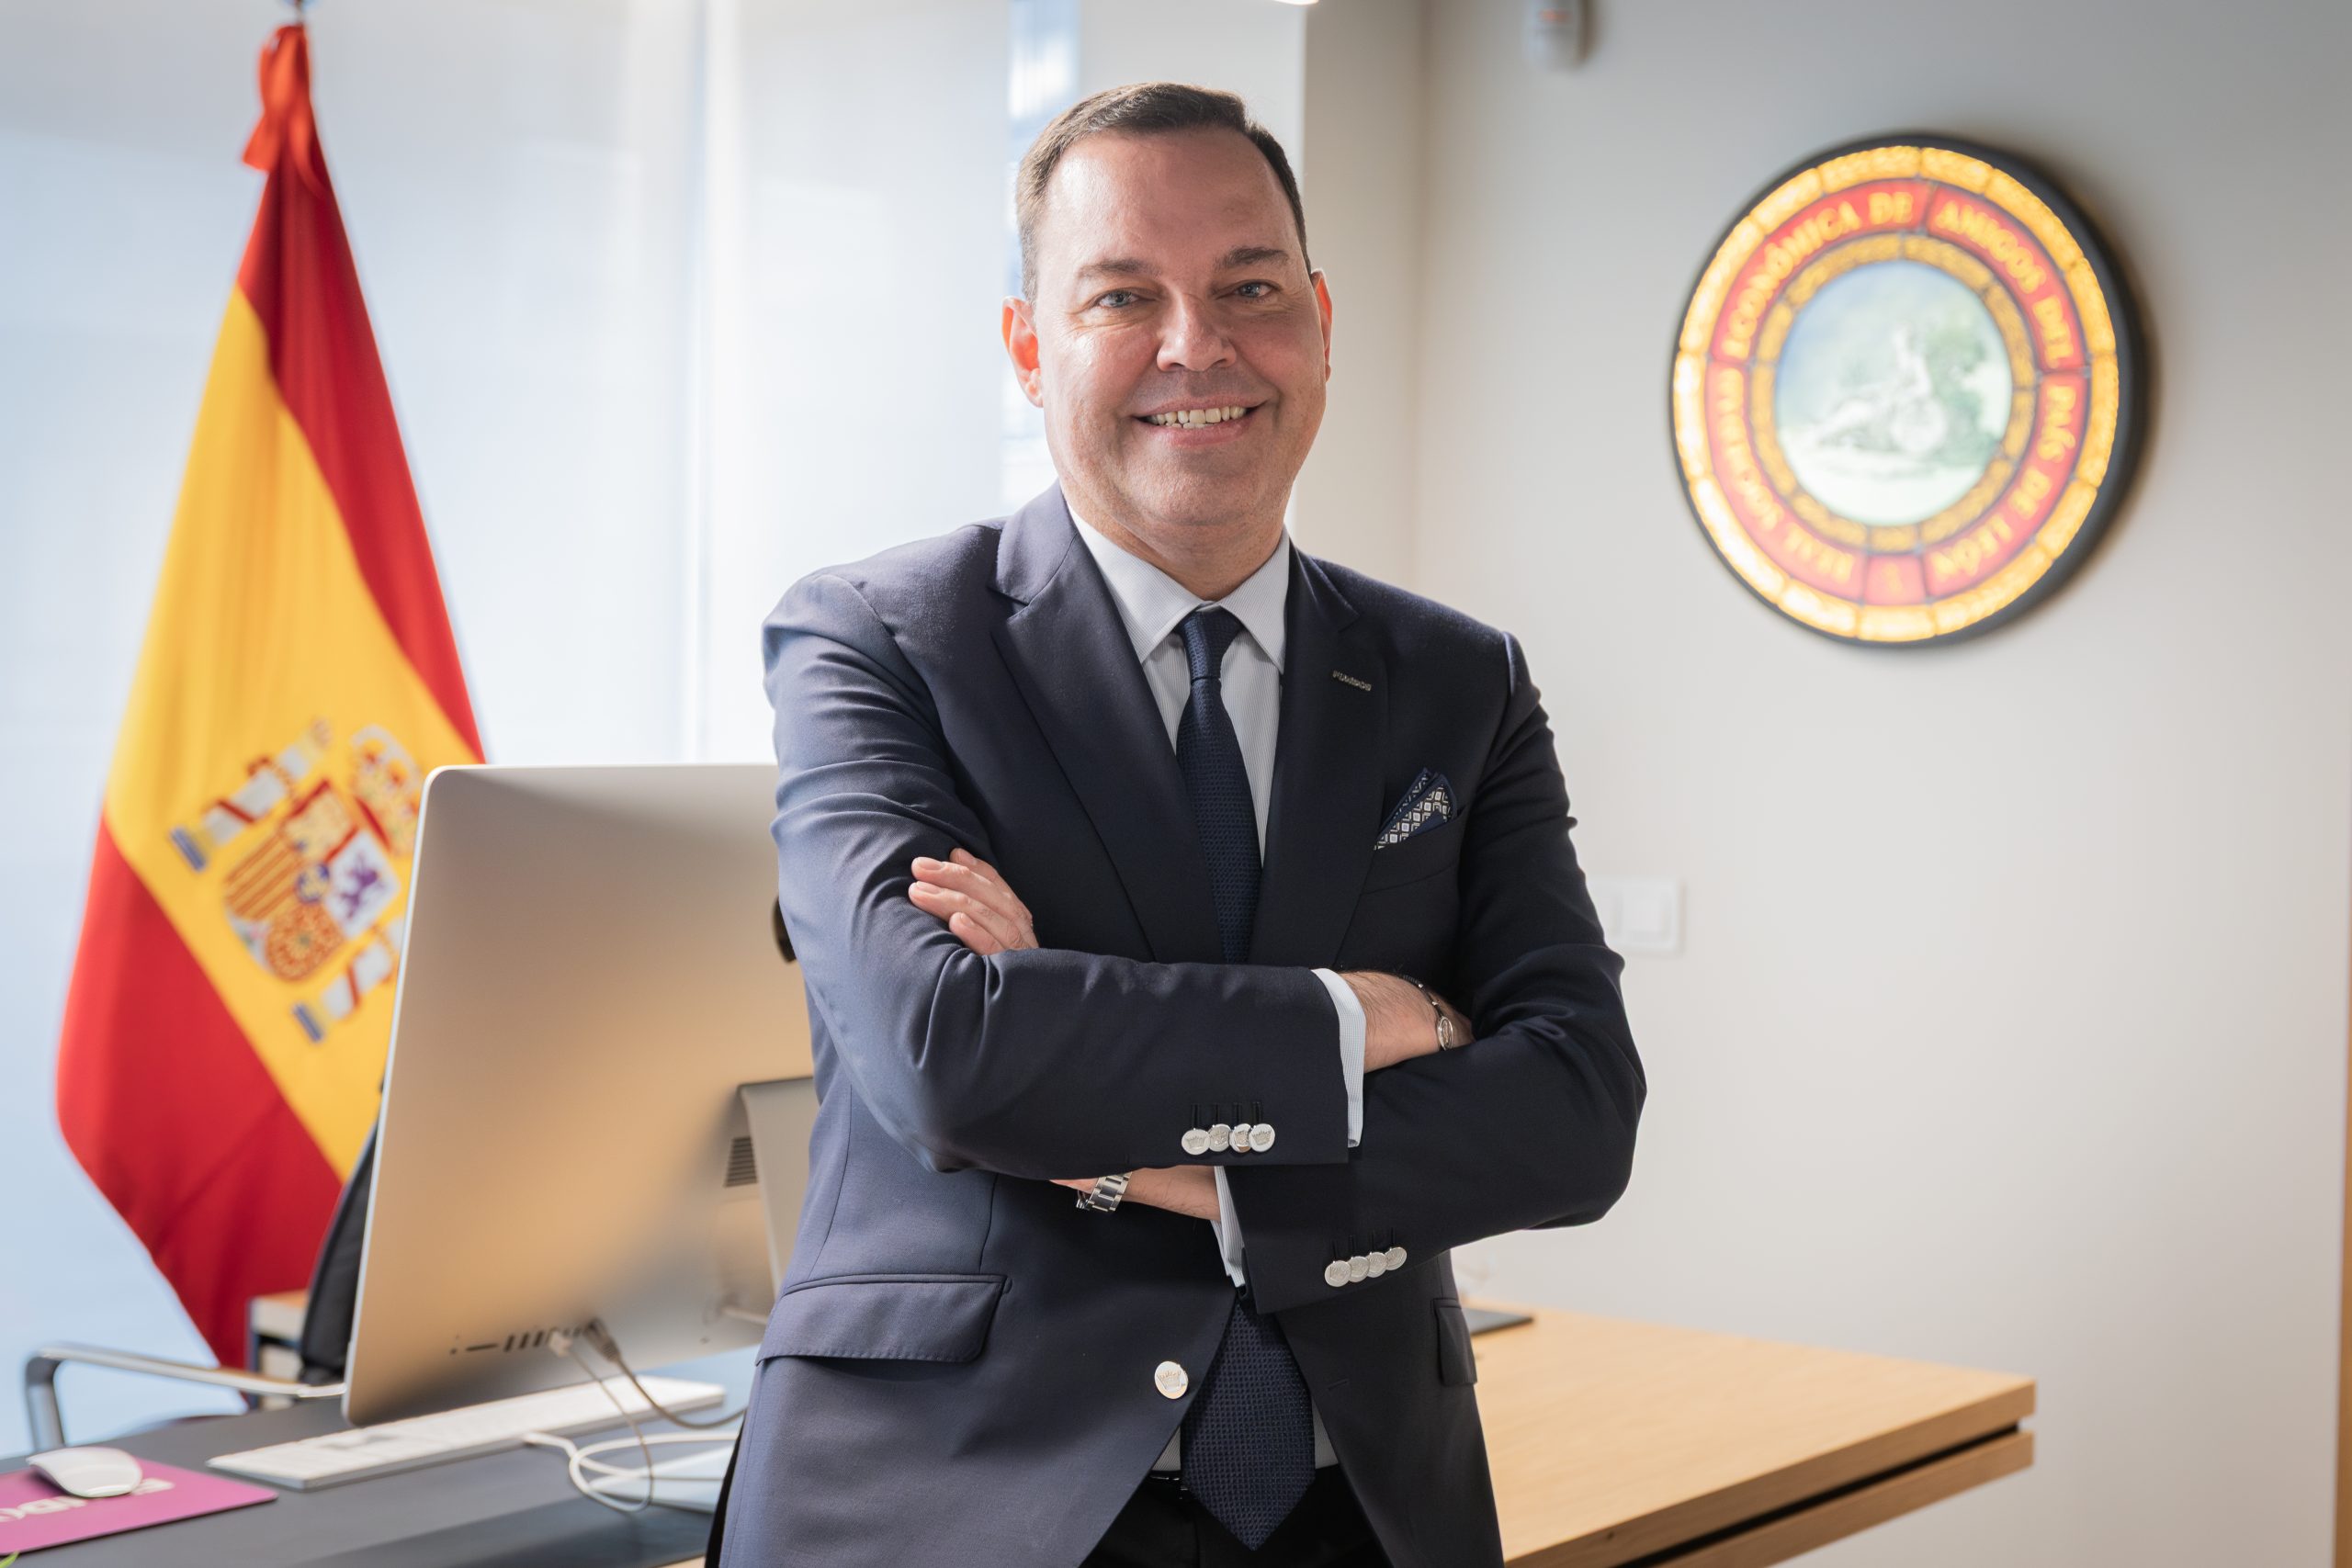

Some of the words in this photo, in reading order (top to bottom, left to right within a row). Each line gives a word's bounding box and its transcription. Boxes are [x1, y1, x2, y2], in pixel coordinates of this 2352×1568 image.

[1867, 191, 1914, 224] DE
[1935, 200, 2048, 294] AMIGOS
[2009, 467, 2052, 522] DE
